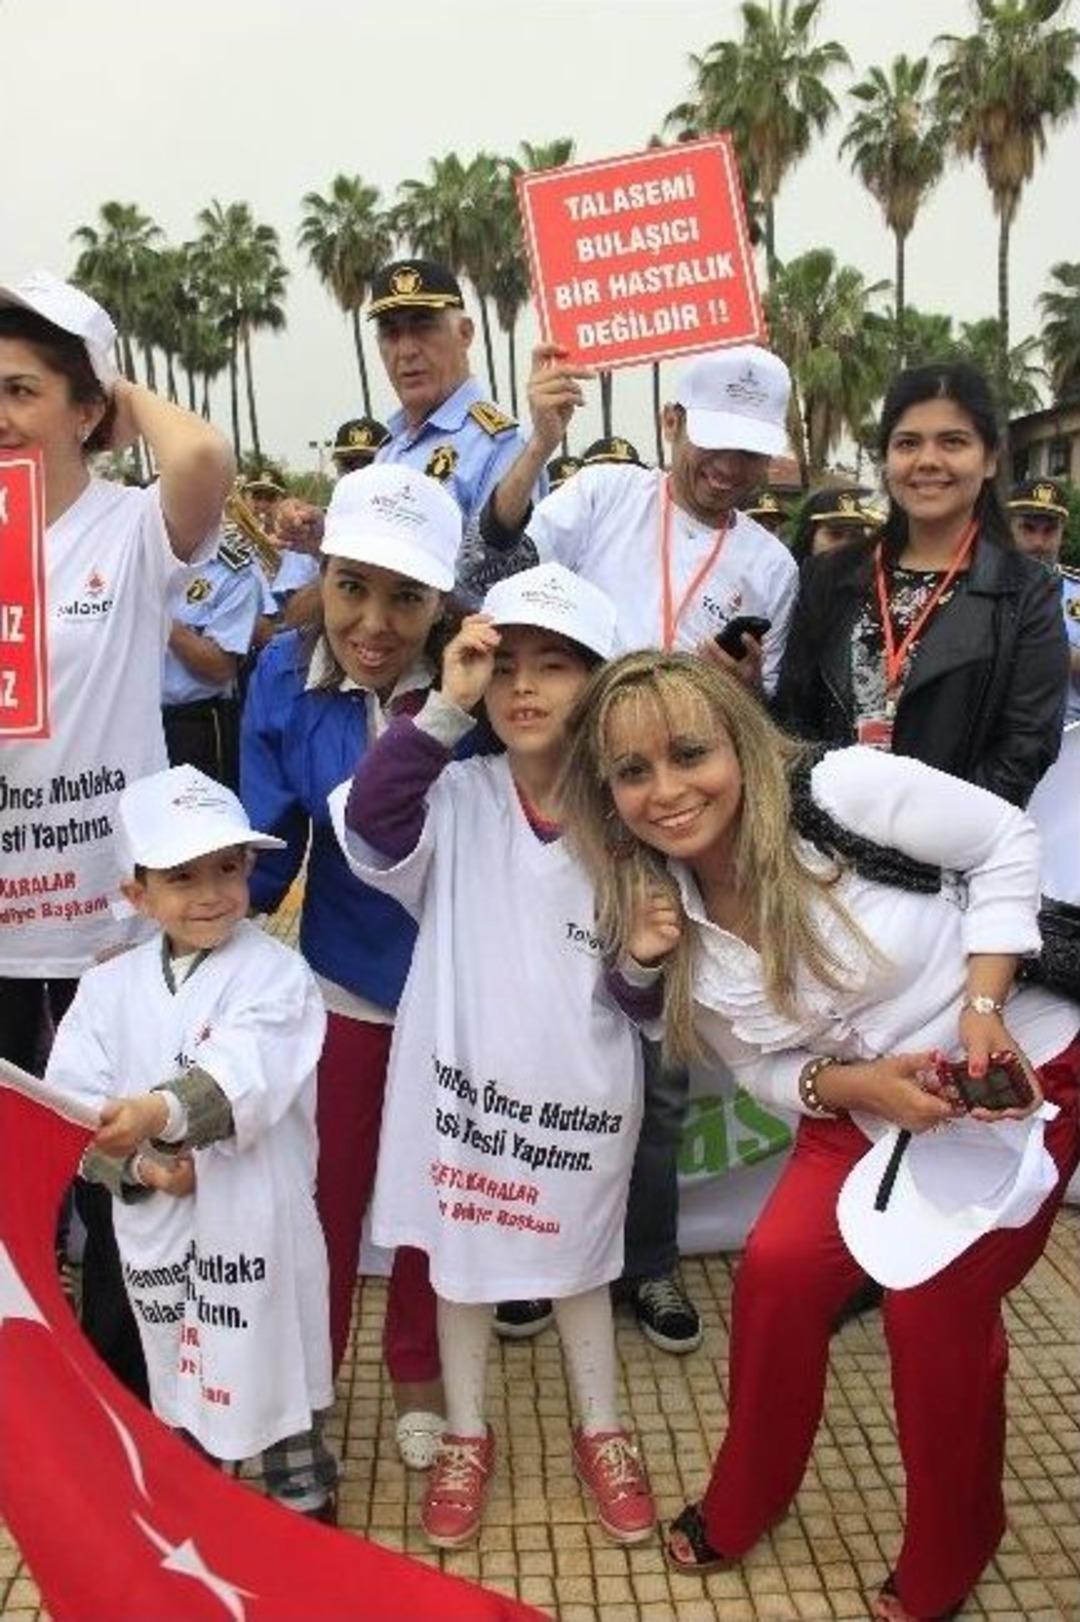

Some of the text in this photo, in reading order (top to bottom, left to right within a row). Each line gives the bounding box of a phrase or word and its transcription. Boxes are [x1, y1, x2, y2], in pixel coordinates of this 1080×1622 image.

[564, 168, 696, 222] TALASEMİ
[576, 216, 700, 263] BULAŞICI
[554, 252, 735, 311] BİR HASTALIK
[576, 302, 701, 349] DEĞİLDİR
[49, 765, 126, 804] Mutlaka
[483, 1080, 532, 1124] Önce
[539, 1102, 622, 1134] Mutlaka
